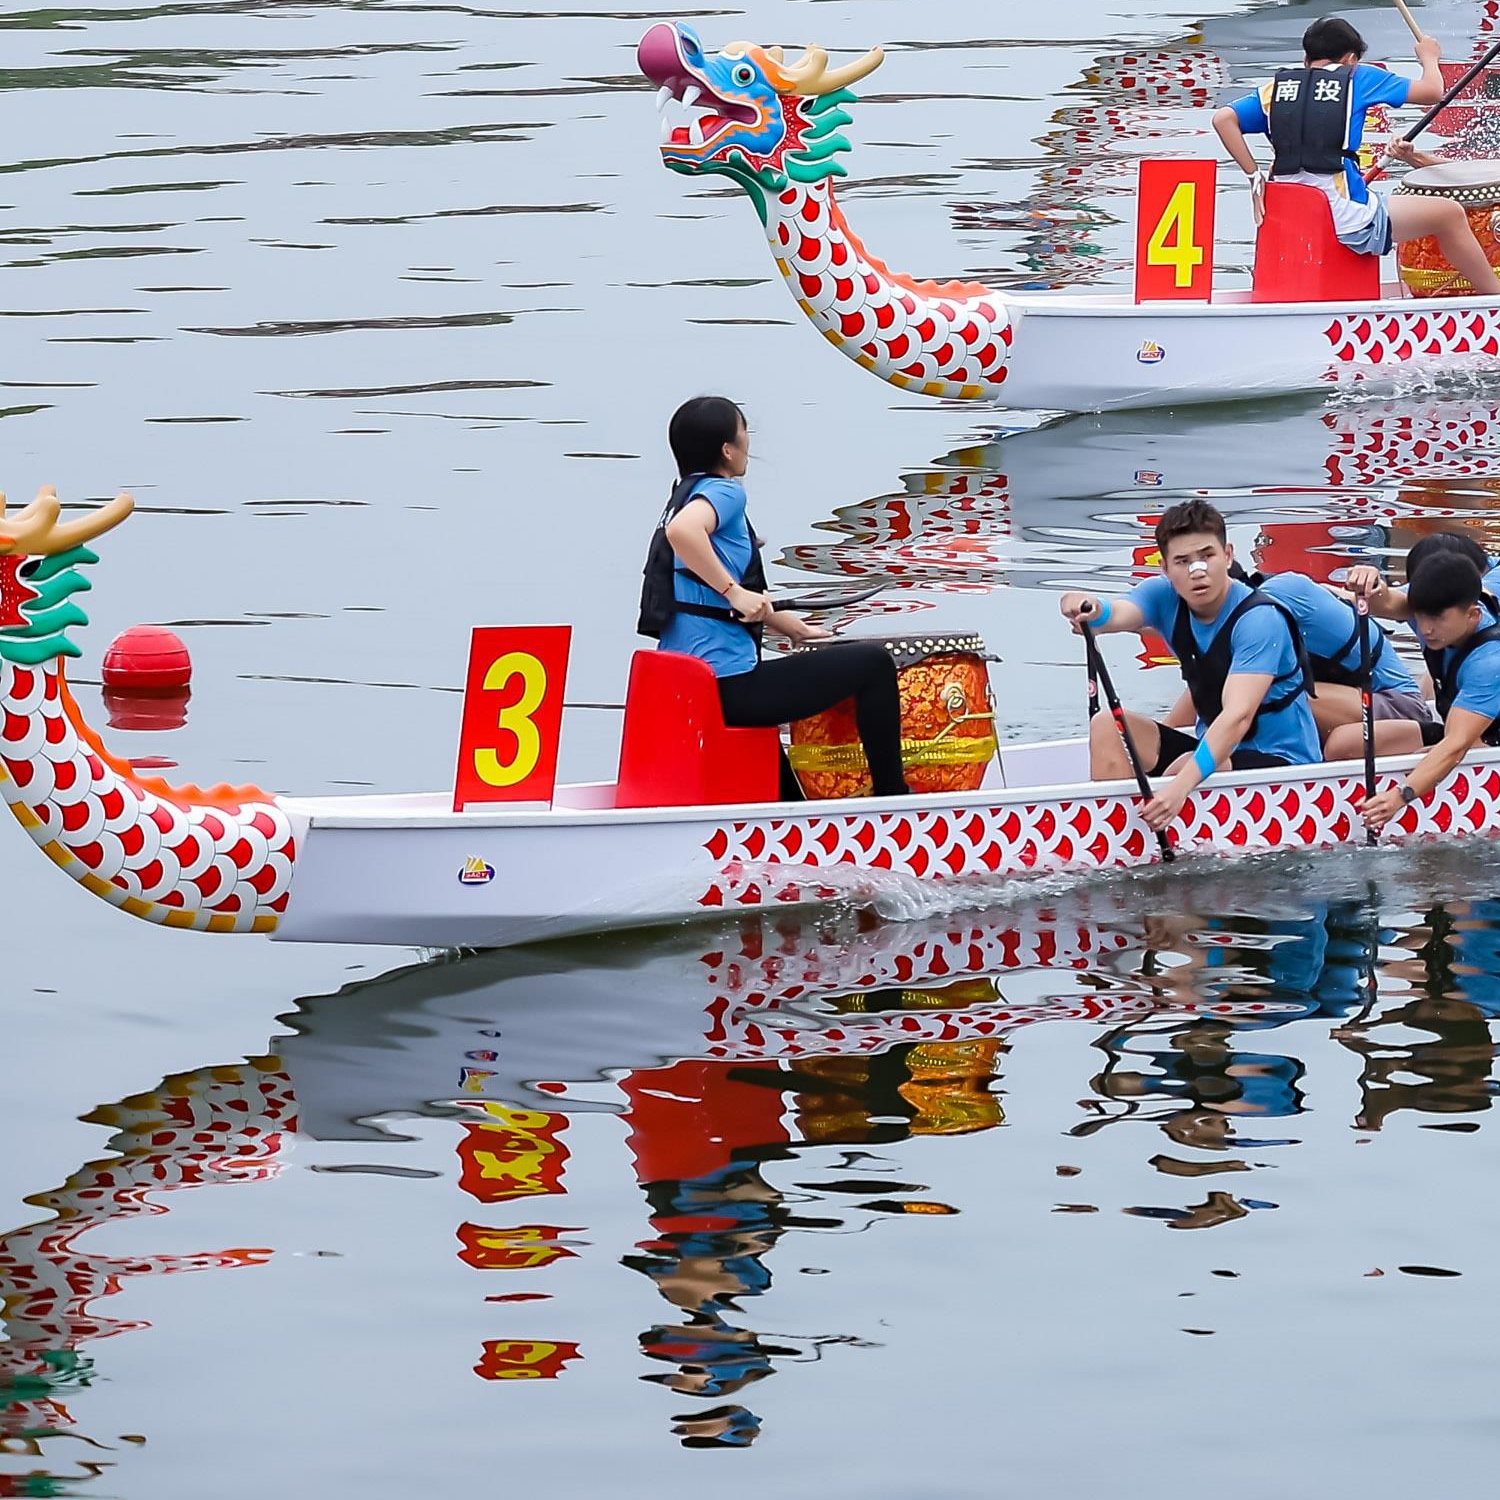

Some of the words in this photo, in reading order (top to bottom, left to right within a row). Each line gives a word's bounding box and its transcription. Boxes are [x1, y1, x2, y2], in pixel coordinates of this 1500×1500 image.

[1275, 78, 1342, 102] 南投
[1147, 182, 1203, 287] 4
[474, 651, 547, 787] 3
